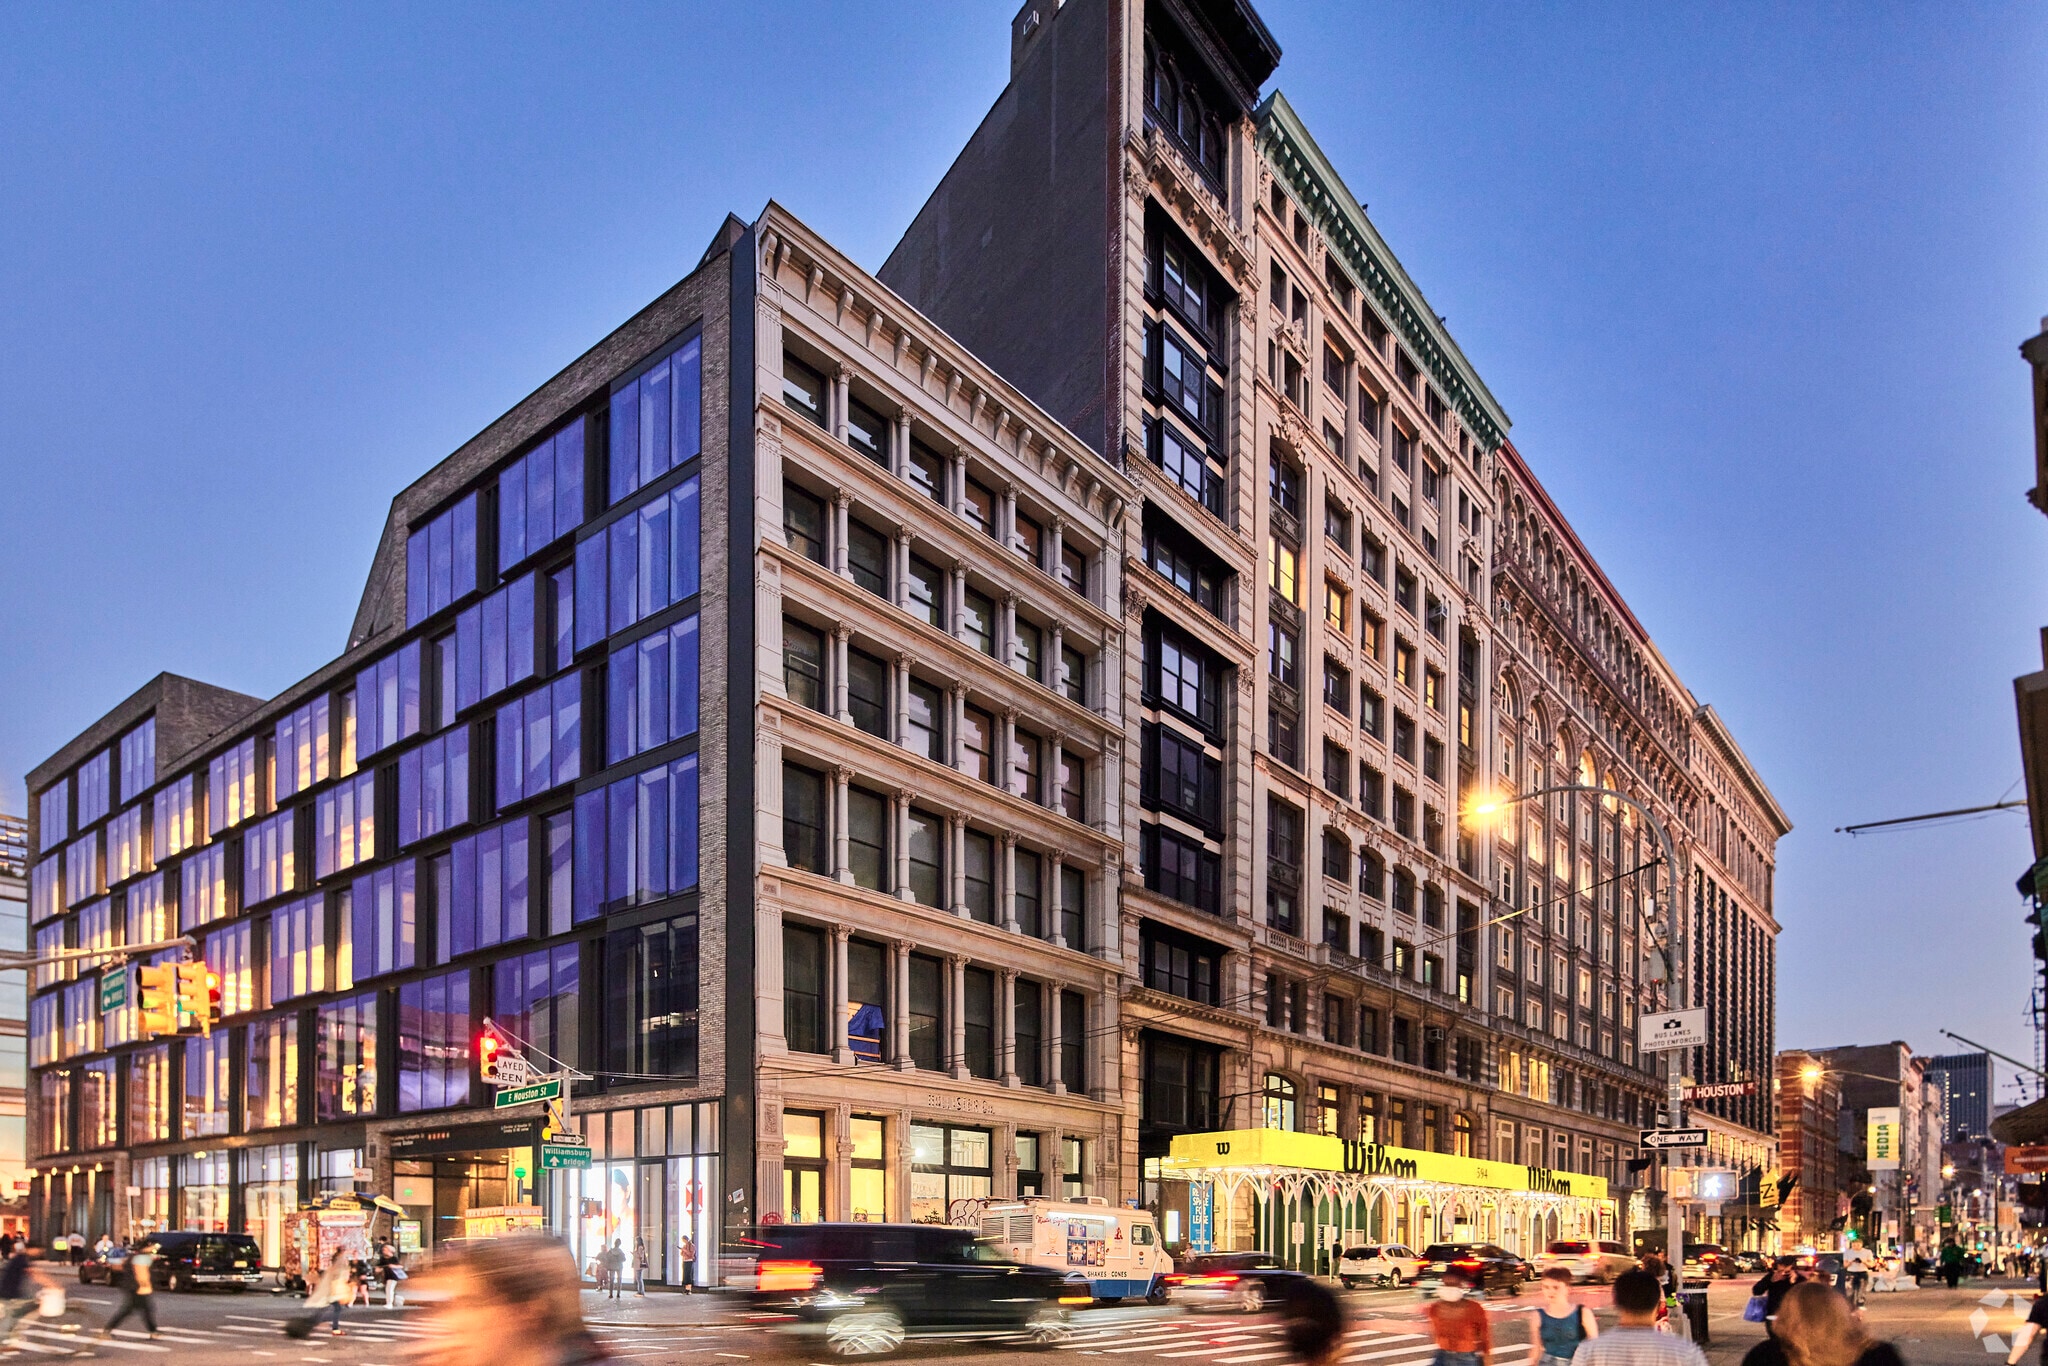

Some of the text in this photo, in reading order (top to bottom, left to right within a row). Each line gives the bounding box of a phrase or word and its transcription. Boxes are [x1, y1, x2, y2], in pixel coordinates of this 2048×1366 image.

[1654, 1029, 1691, 1039] BUS LANES
[1644, 1036, 1702, 1048] PHOTO ENFORCED
[489, 1073, 523, 1083] REEN
[508, 1085, 547, 1102] E Houston St
[1684, 1088, 1693, 1099] W
[1696, 1083, 1744, 1098] HOUSTON
[1650, 1134, 1699, 1143] ONE WAY
[1877, 1124, 1889, 1158] MEDIA
[544, 1148, 590, 1157] Williamsburg
[563, 1158, 586, 1166] Bridge
[1341, 1139, 1417, 1179] Wilson
[1477, 1167, 1488, 1179] 594
[1527, 1166, 1571, 1196] Wilson
